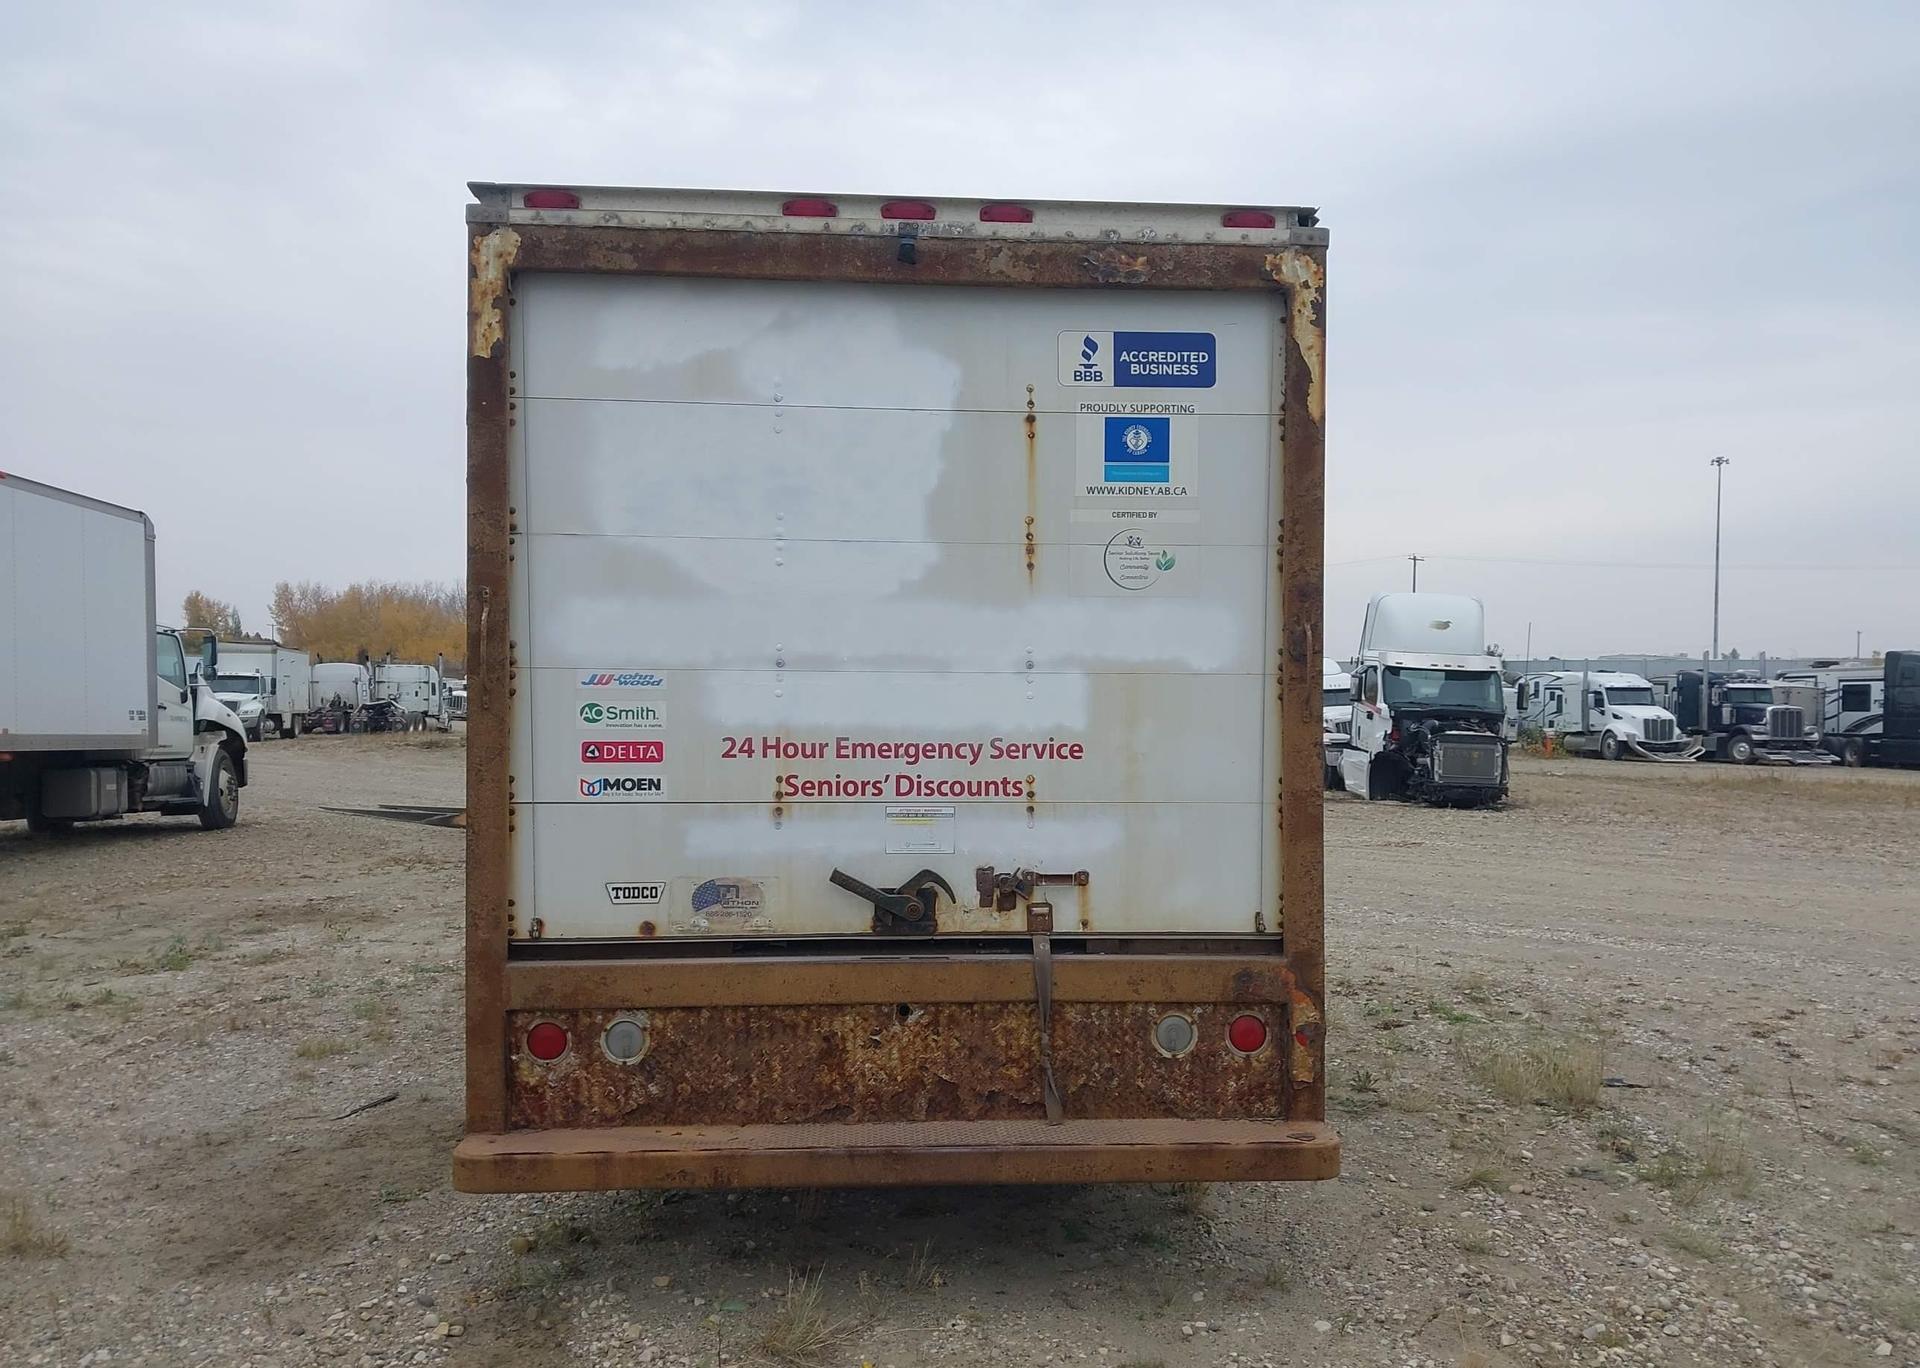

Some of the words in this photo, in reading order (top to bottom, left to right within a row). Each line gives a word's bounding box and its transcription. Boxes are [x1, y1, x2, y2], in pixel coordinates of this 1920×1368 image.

[1119, 351, 1209, 363] ACCREDITED
[1073, 370, 1104, 382] BBB
[1130, 364, 1199, 376] BUSINESS
[1080, 403, 1127, 412] PROUDLY
[1130, 404, 1195, 414] SUPPORTING
[1086, 486, 1188, 496] WWW.KIDNEY.AB.CA
[1111, 511, 1147, 519] CERTIFIED
[1148, 511, 1157, 519] BY
[603, 745, 659, 759] DELTA
[721, 737, 755, 759] 24
[762, 737, 829, 760] Hour
[835, 737, 984, 765] Emergency
[989, 737, 1084, 760] Service
[603, 778, 662, 791] MOEN
[895, 774, 1024, 797] Discounts
[611, 886, 659, 900] TODCO
